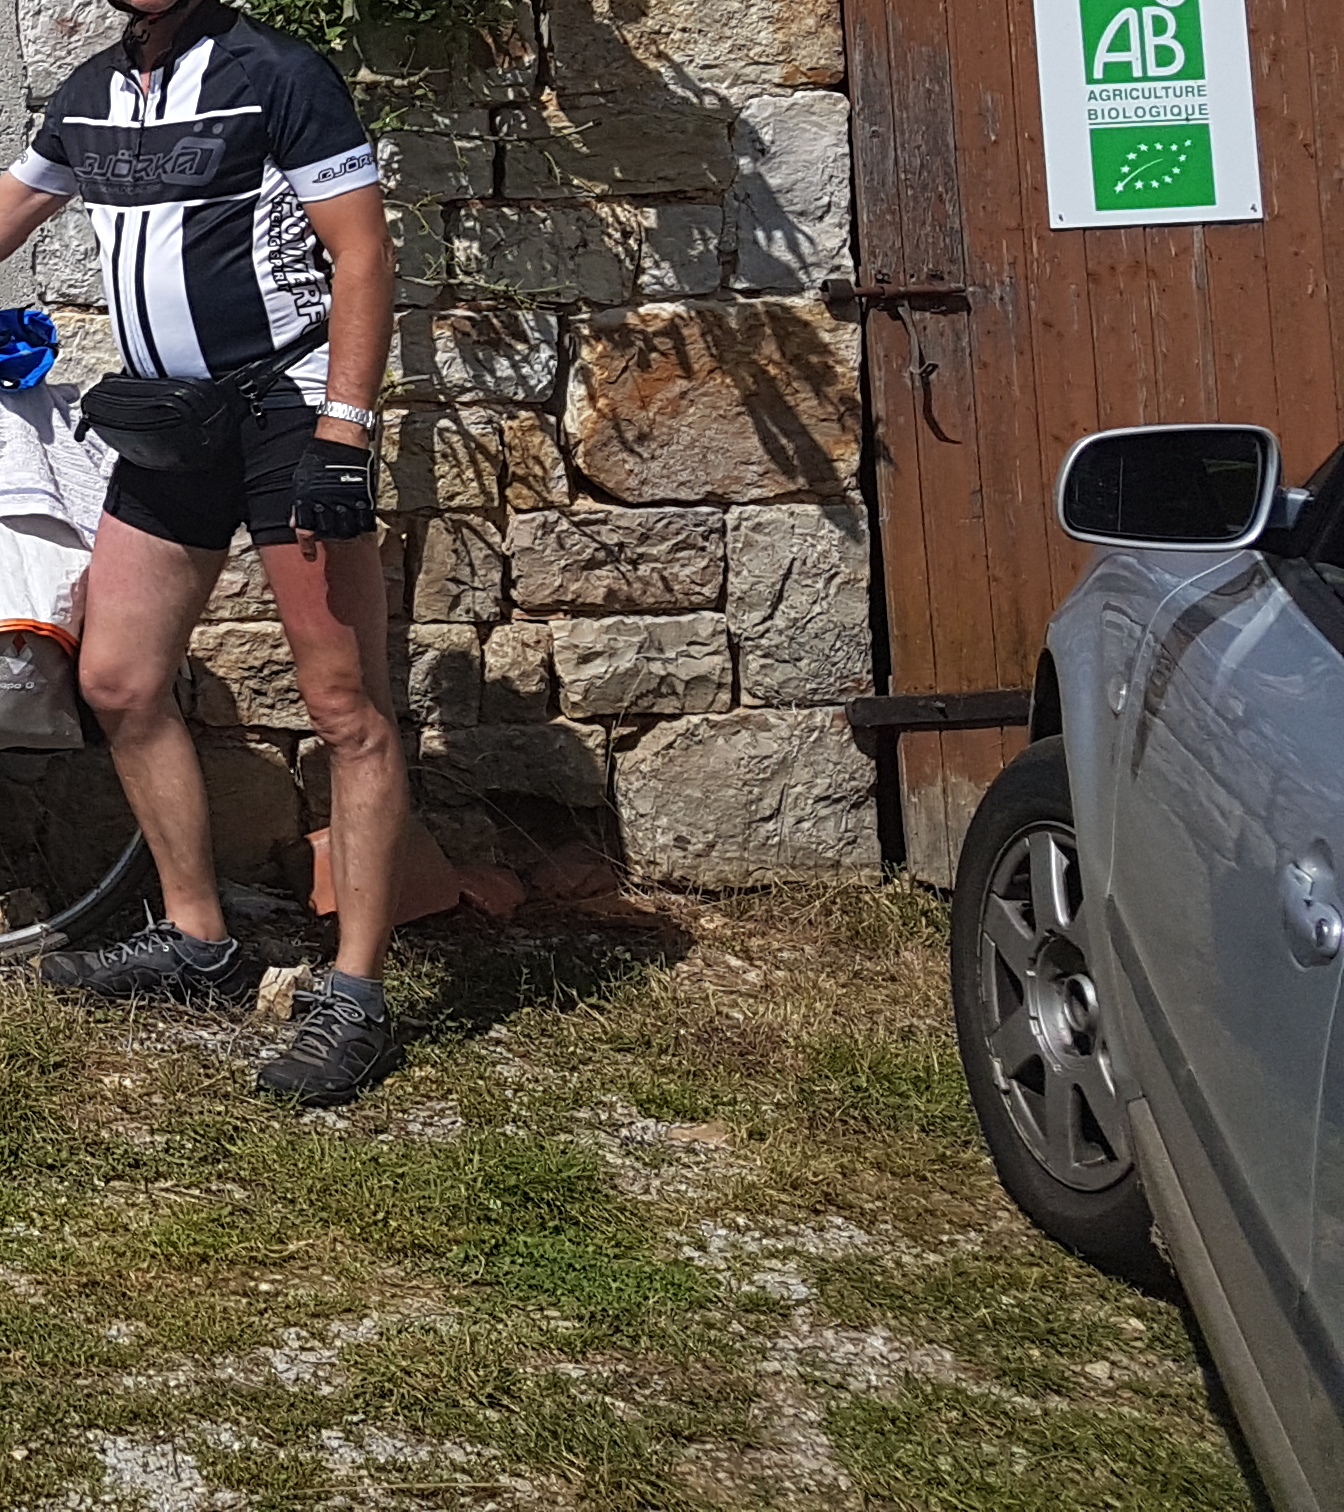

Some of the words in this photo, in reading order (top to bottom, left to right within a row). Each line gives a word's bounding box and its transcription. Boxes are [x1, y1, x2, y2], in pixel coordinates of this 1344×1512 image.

[1093, 6, 1187, 79] AB
[1087, 85, 1208, 102] AGRICULTURE
[1087, 103, 1209, 121] BIOLOGIQUE
